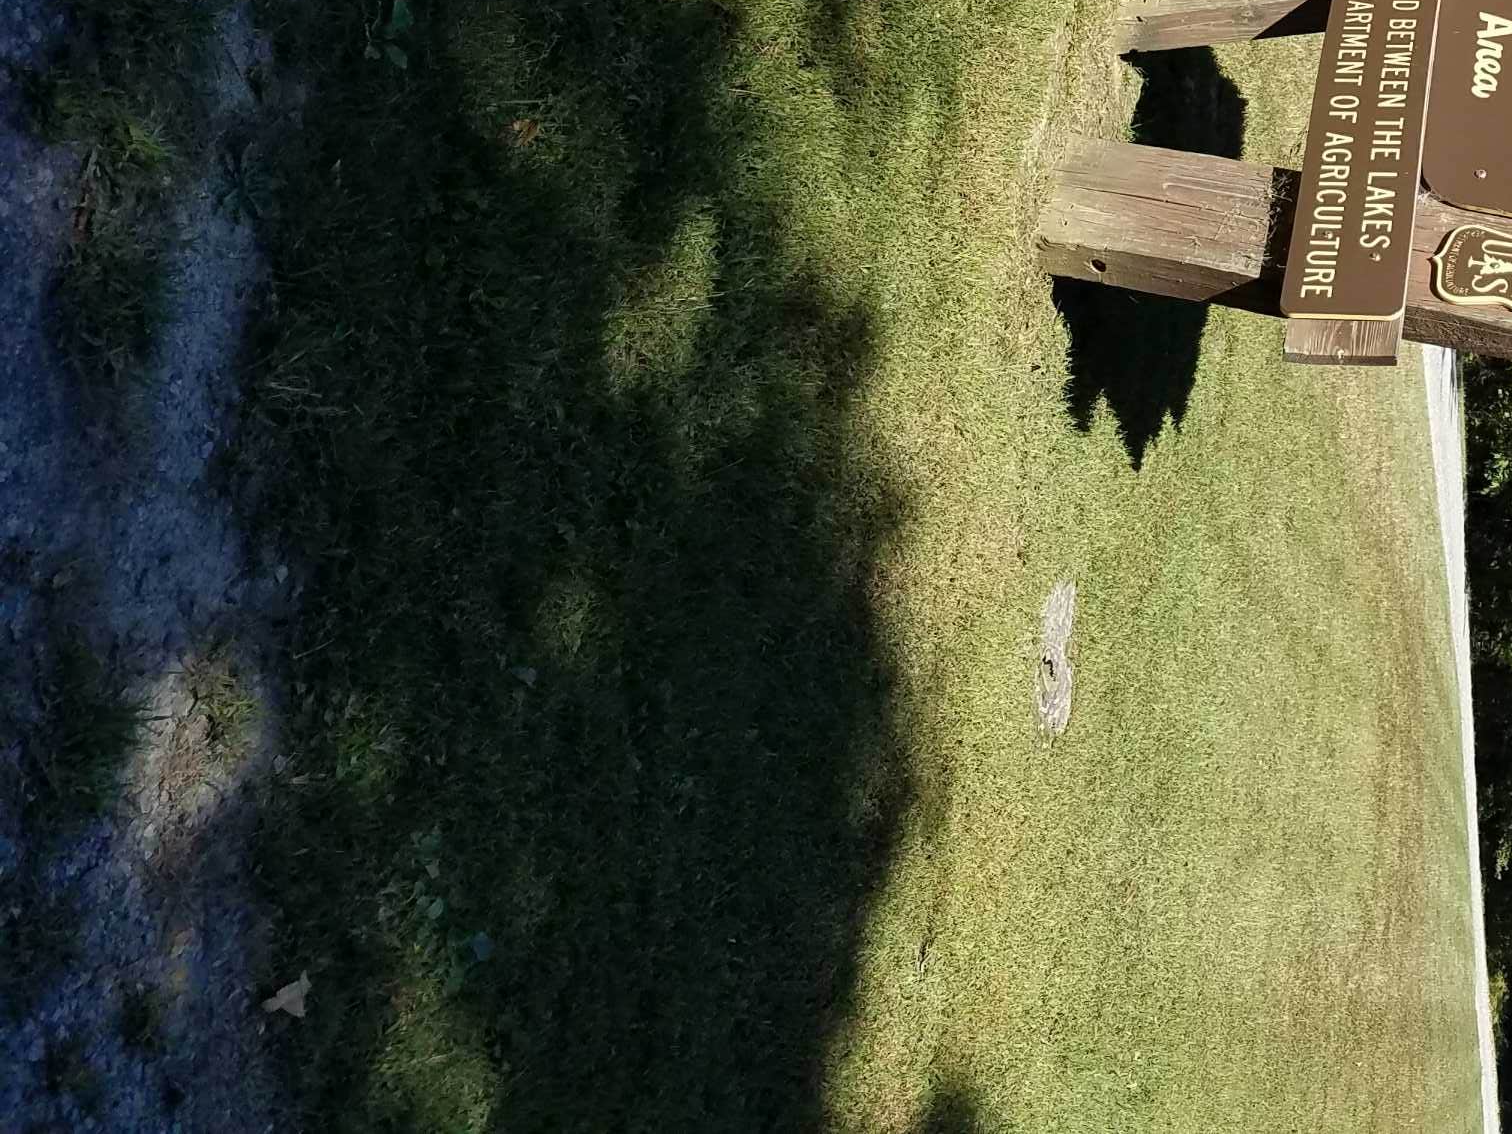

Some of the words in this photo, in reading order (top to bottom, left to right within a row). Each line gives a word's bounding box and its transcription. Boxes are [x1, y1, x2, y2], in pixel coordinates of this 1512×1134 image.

[1378, 18, 1417, 108] BETWEEN
[1328, 95, 1360, 124] OF
[1370, 117, 1404, 161] THE
[1300, 132, 1354, 298] AGRICULTURE
[1360, 171, 1398, 249] LAKES
